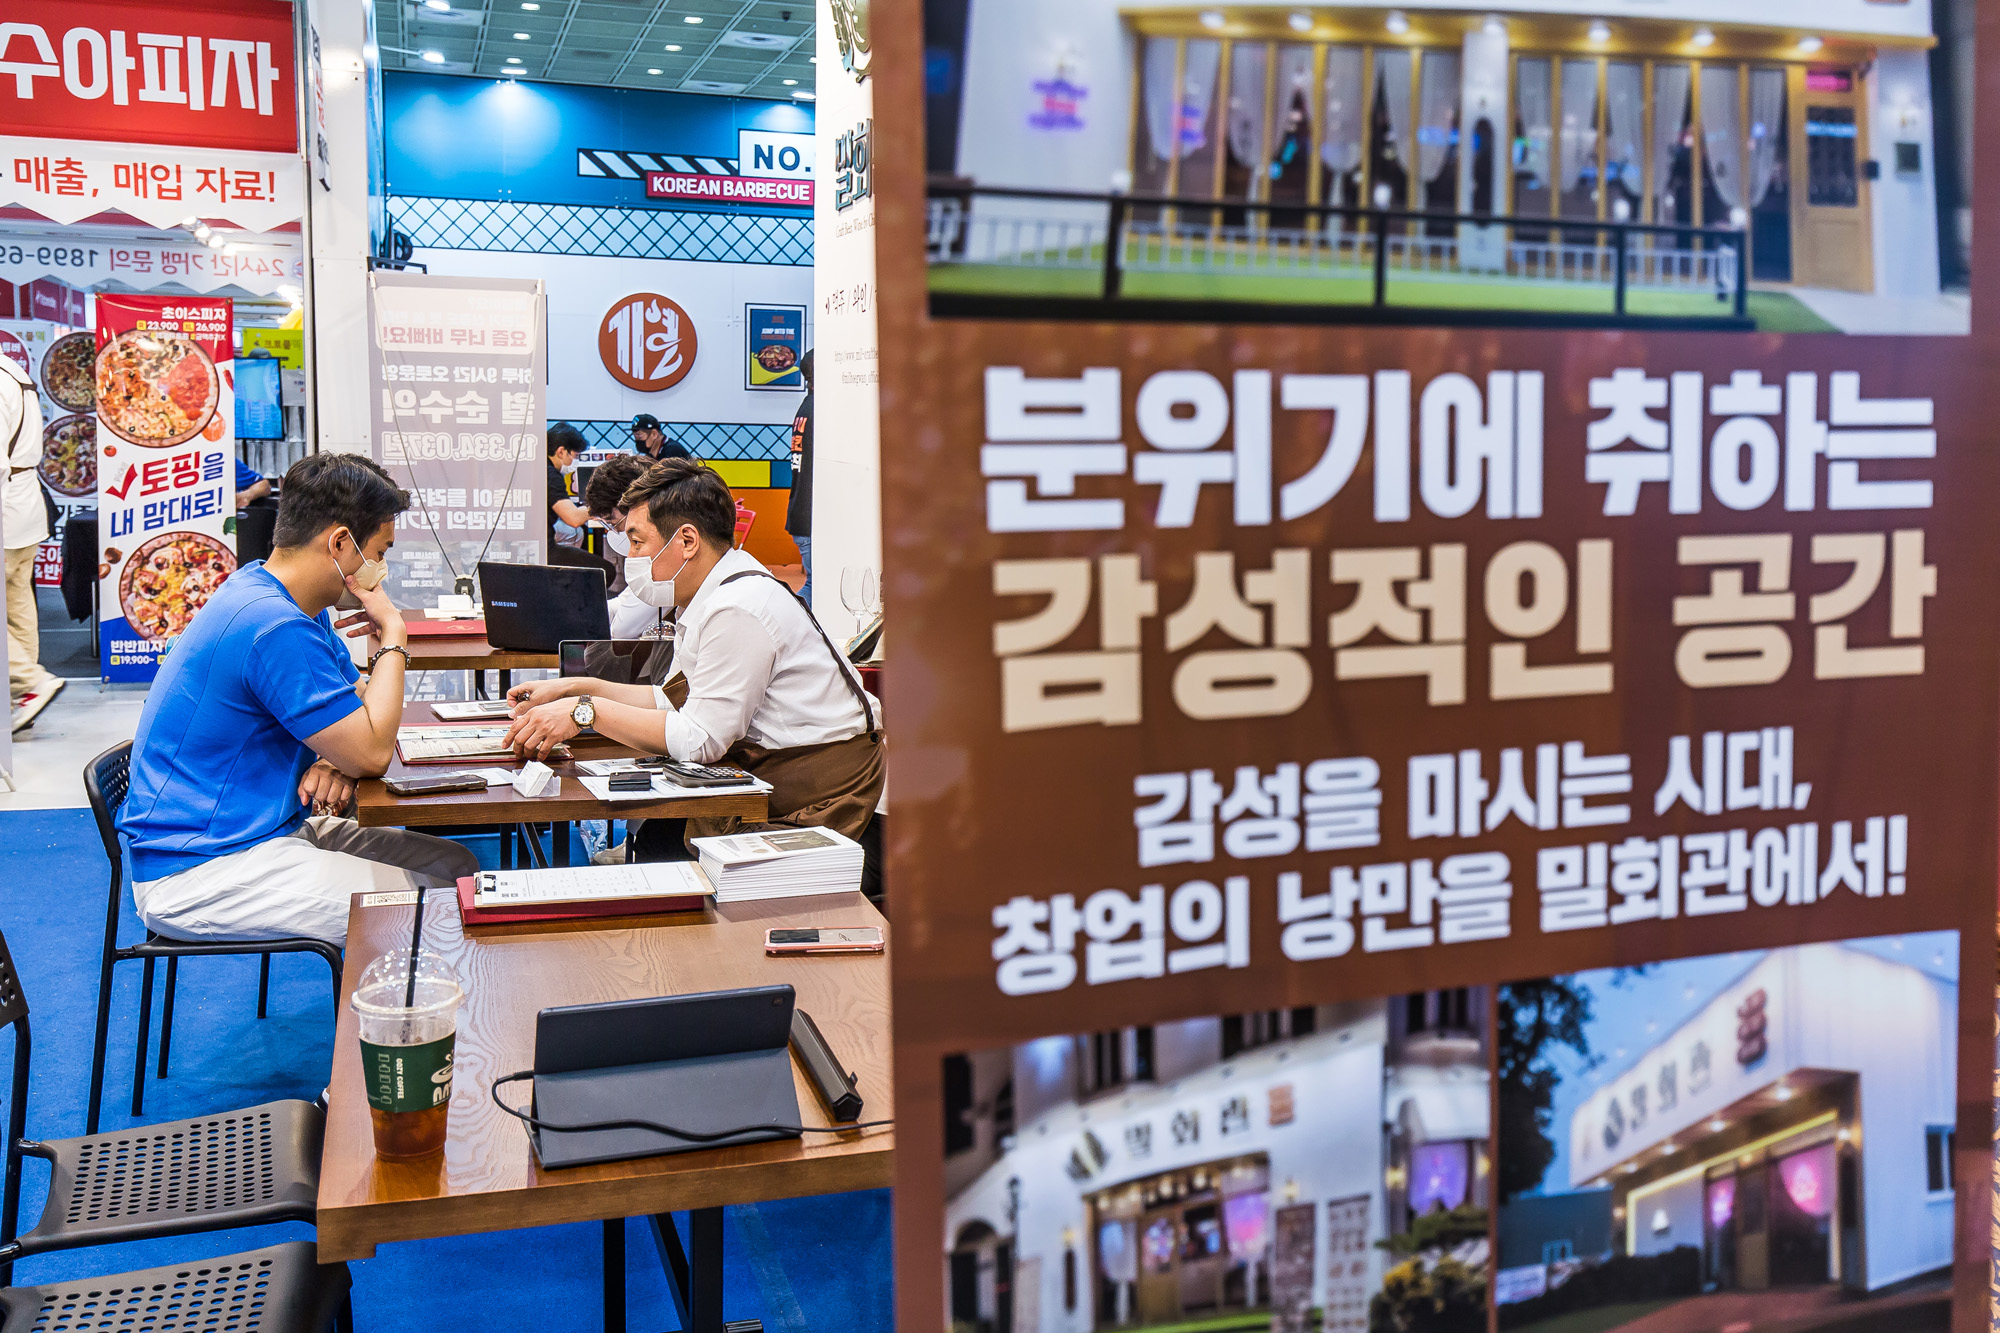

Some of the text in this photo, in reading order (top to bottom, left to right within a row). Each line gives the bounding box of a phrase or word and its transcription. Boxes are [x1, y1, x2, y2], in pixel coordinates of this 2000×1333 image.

[0, 22, 279, 116] 수아피자
[14, 157, 275, 203] 매출, 매입 자료!
[754, 144, 811, 173] NO.
[653, 176, 810, 201] KOREAN BARBECUE
[161, 306, 226, 321] 초이스피자
[981, 366, 1937, 533] 분위기에 취하는
[140, 451, 224, 497] 토핑을
[110, 508, 134, 538] 내
[143, 487, 223, 531] 맘대로!
[491, 600, 518, 608] SAMSUNG
[110, 640, 163, 654] 반반피자
[992, 529, 1938, 734] 감성적인 공간
[1134, 726, 1813, 868] 감성을 마시는 시대,
[992, 815, 1908, 997] 창업의 낭만을 밀회관에서!
